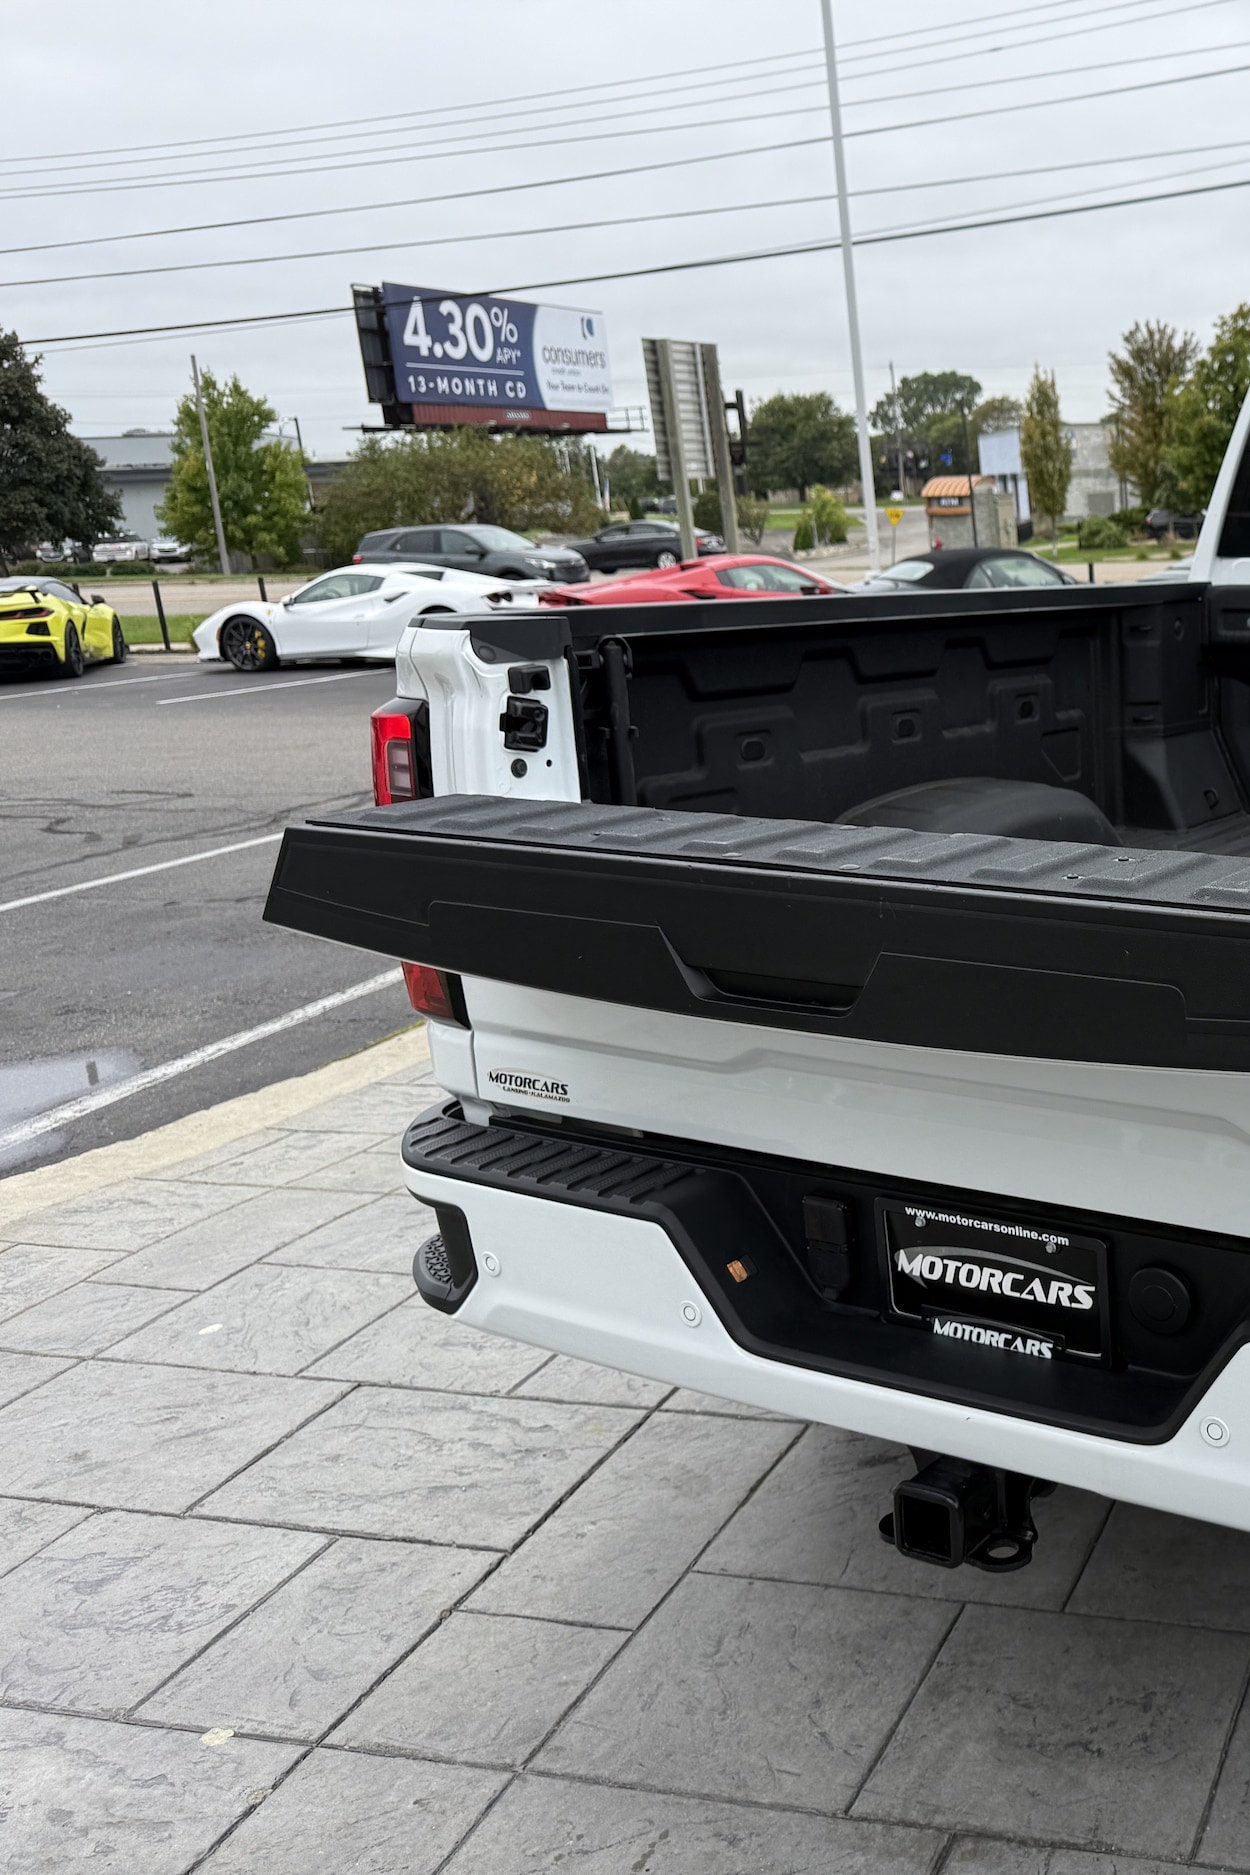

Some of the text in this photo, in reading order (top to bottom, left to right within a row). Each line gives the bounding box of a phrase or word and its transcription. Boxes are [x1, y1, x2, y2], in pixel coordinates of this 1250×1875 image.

[403, 296, 519, 363] 4.30%
[542, 345, 606, 369] consumers
[407, 374, 527, 398] 13-MONTH CD
[488, 1070, 569, 1096] MOTORCARS
[904, 1206, 1070, 1247] www.motorcarsonline.com
[897, 1248, 1096, 1311] MOTORCARS
[932, 1317, 1055, 1360] MOTORCARS
